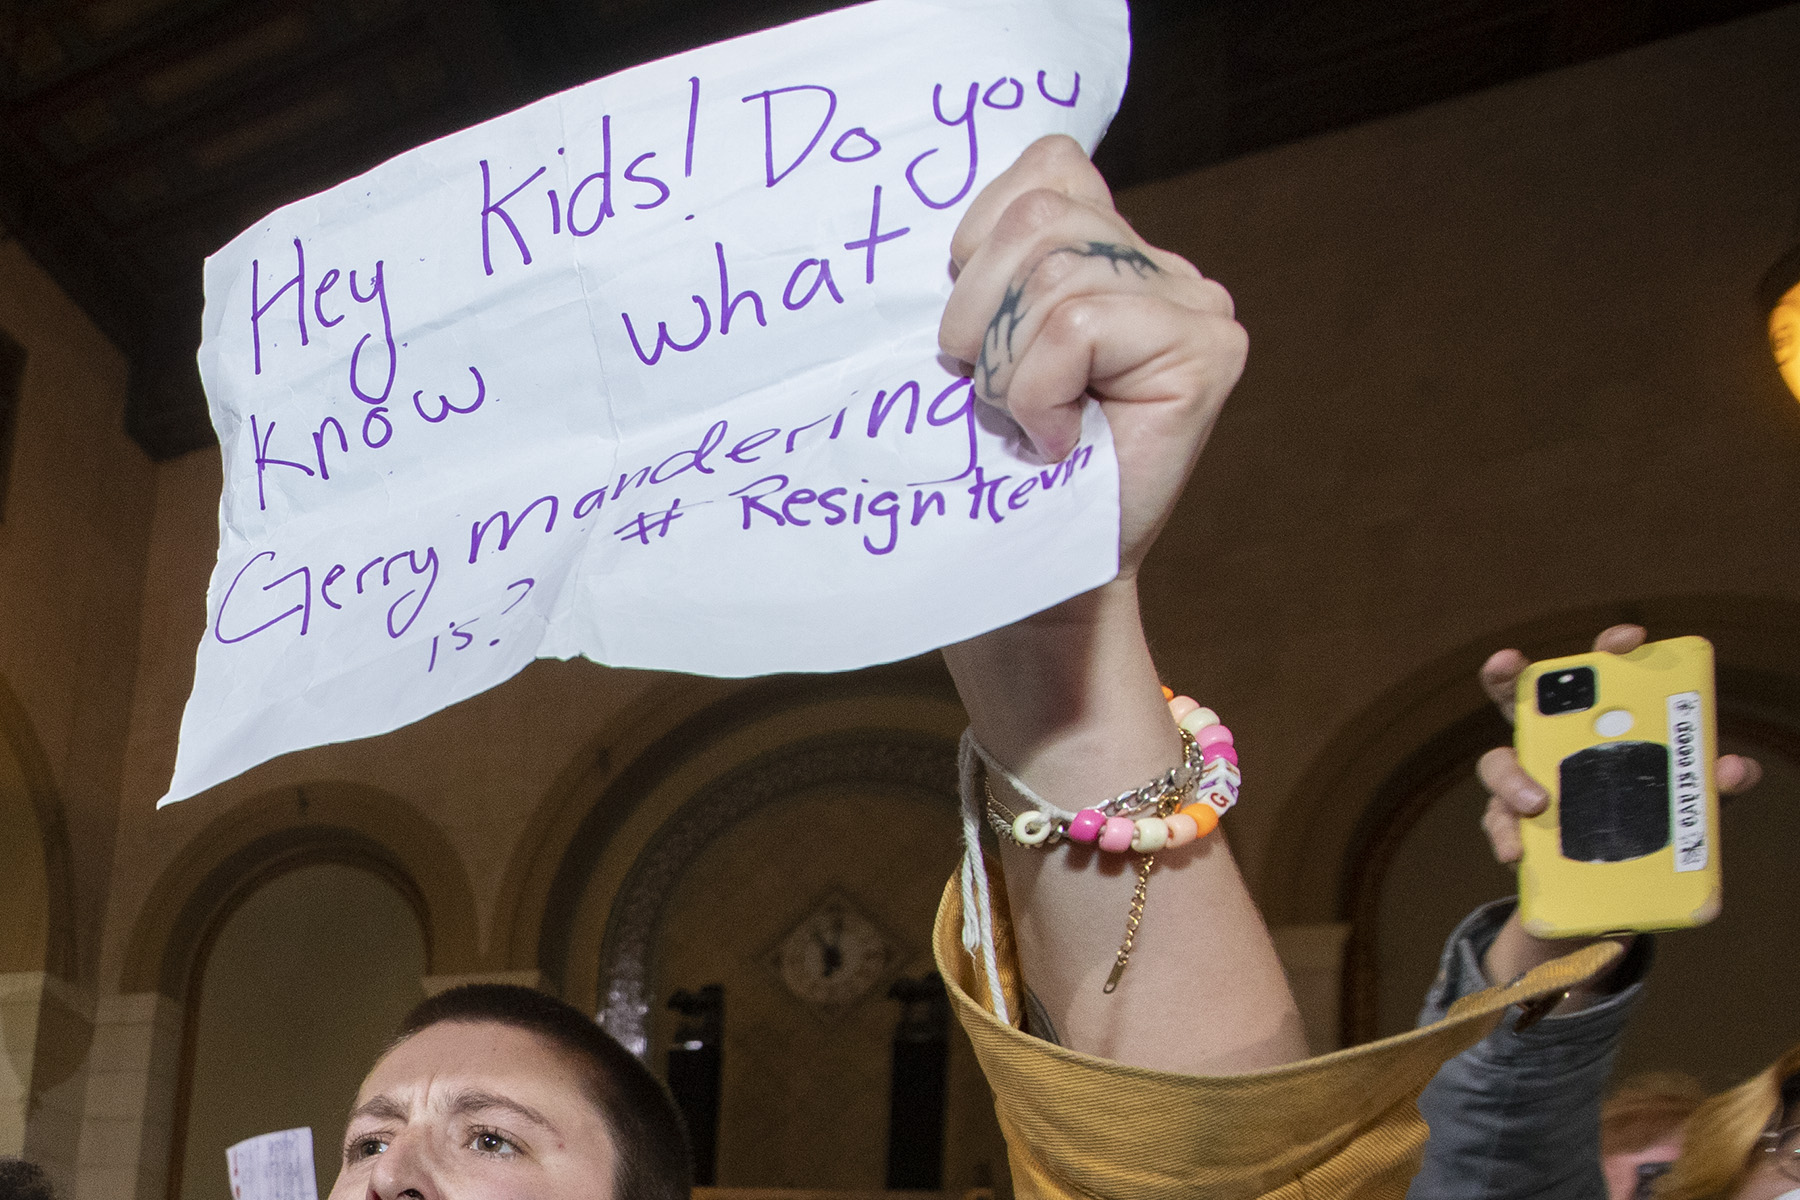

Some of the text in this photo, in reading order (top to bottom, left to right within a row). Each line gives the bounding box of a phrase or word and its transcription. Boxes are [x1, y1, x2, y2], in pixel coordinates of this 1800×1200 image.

[250, 69, 1081, 404] Hey Kids! Do you
[621, 184, 911, 367] what
[427, 577, 536, 673] is?
